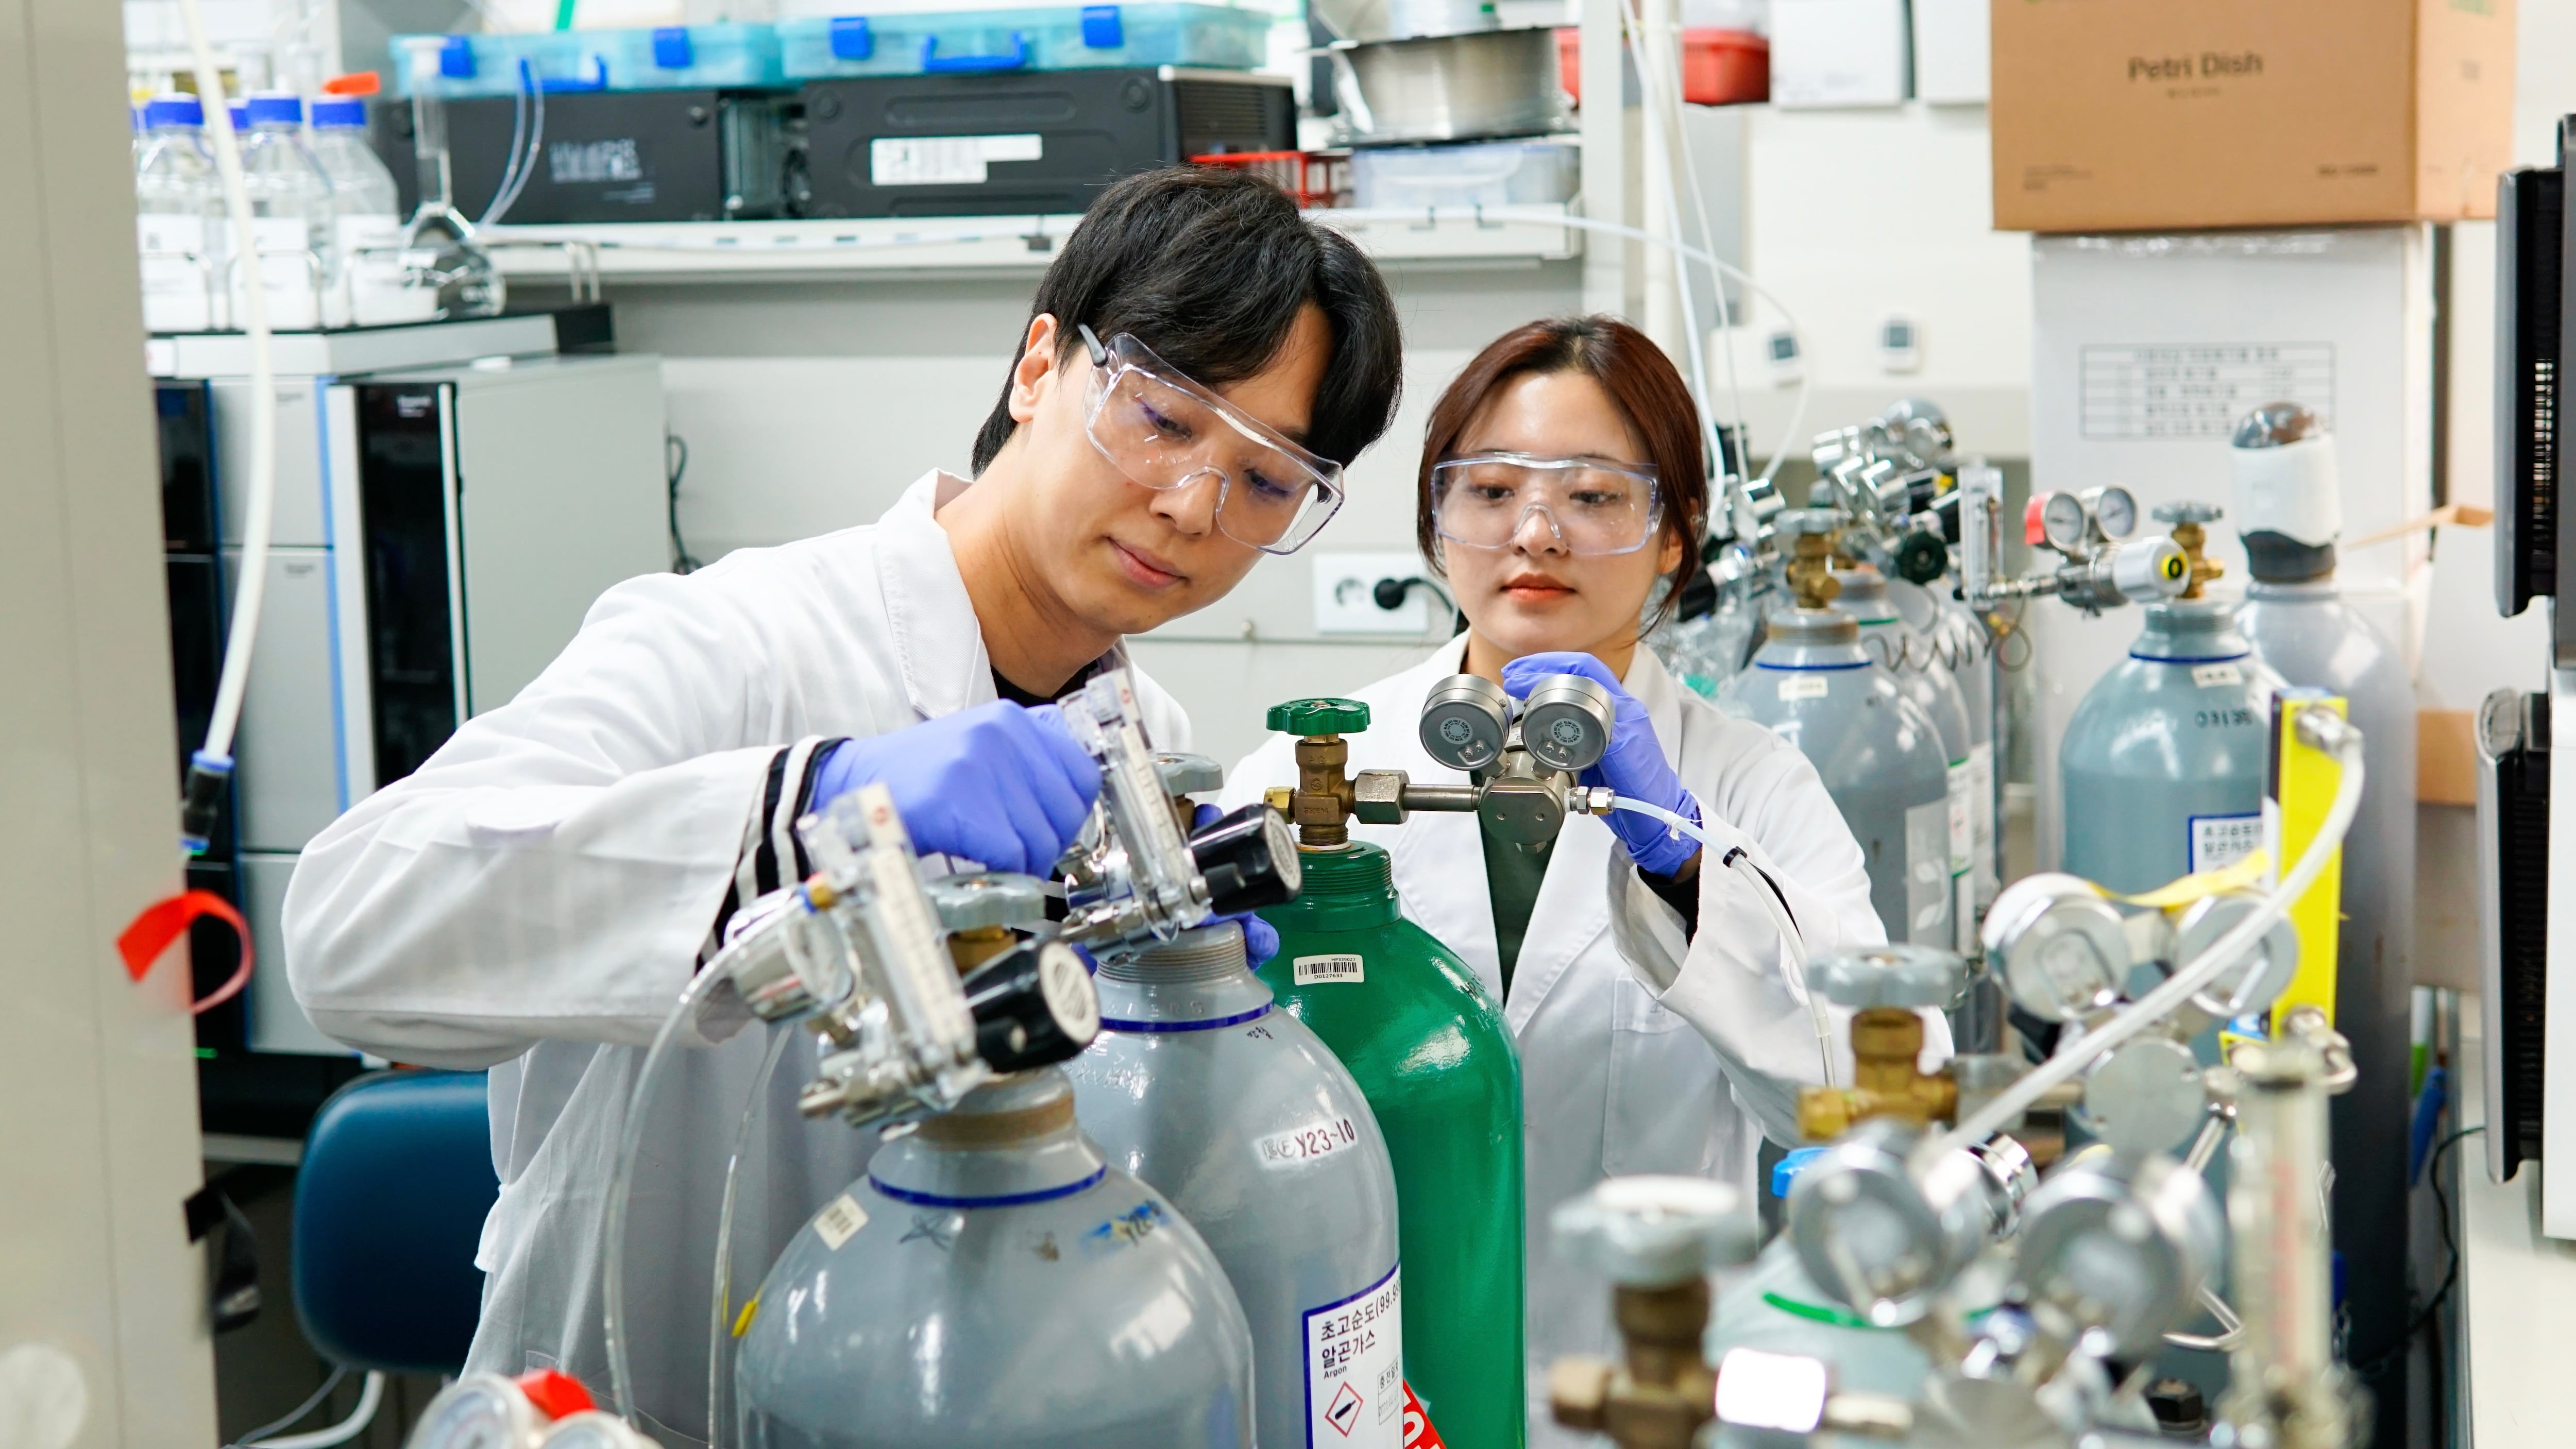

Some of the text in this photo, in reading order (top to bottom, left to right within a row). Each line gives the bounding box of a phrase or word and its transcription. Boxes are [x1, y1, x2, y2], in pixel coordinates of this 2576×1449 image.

[2128, 50, 2263, 81] Petri Dish
[1322, 1329, 1376, 1369] 알곤가스
[1324, 1365, 1347, 1380] Argon
